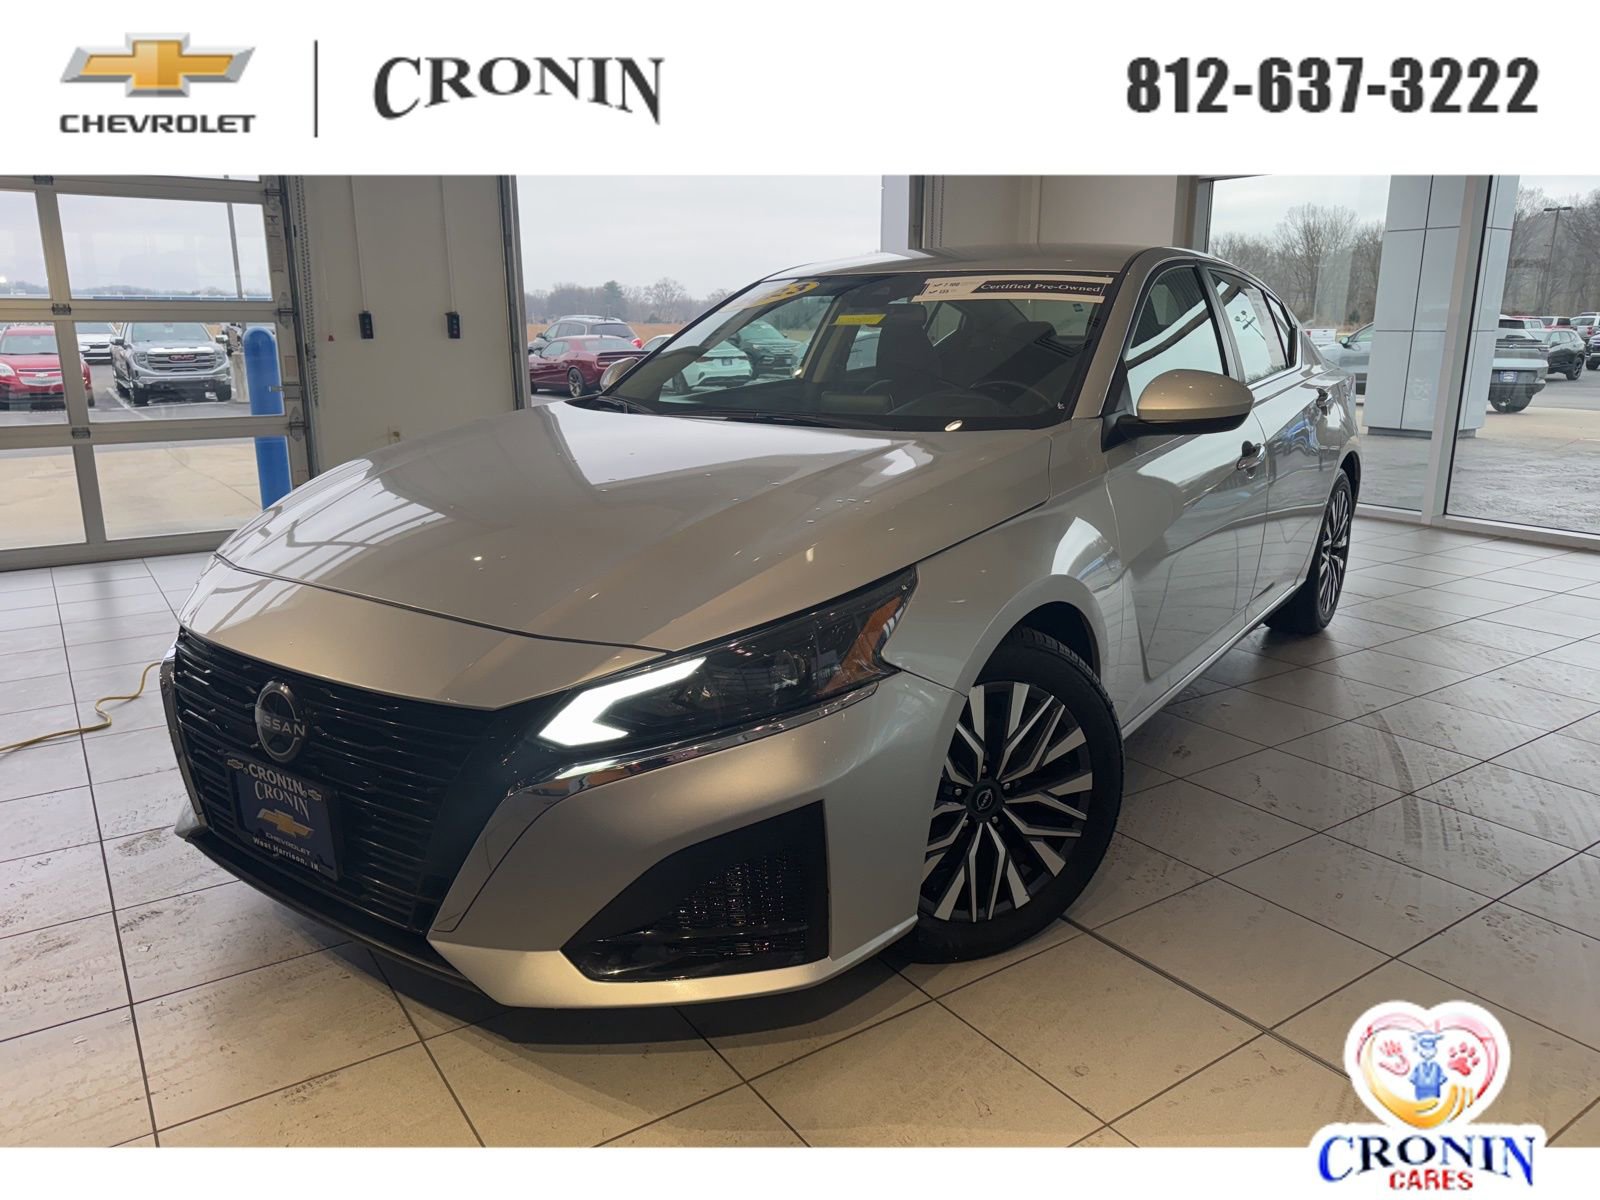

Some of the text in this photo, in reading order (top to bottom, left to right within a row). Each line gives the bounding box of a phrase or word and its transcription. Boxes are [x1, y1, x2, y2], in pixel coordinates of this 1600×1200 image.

[1034, 283, 1101, 293] Pre-Owned
[257, 711, 306, 737] SSAN
[248, 763, 304, 795] CRONIN
[255, 780, 310, 822] CRONIN
